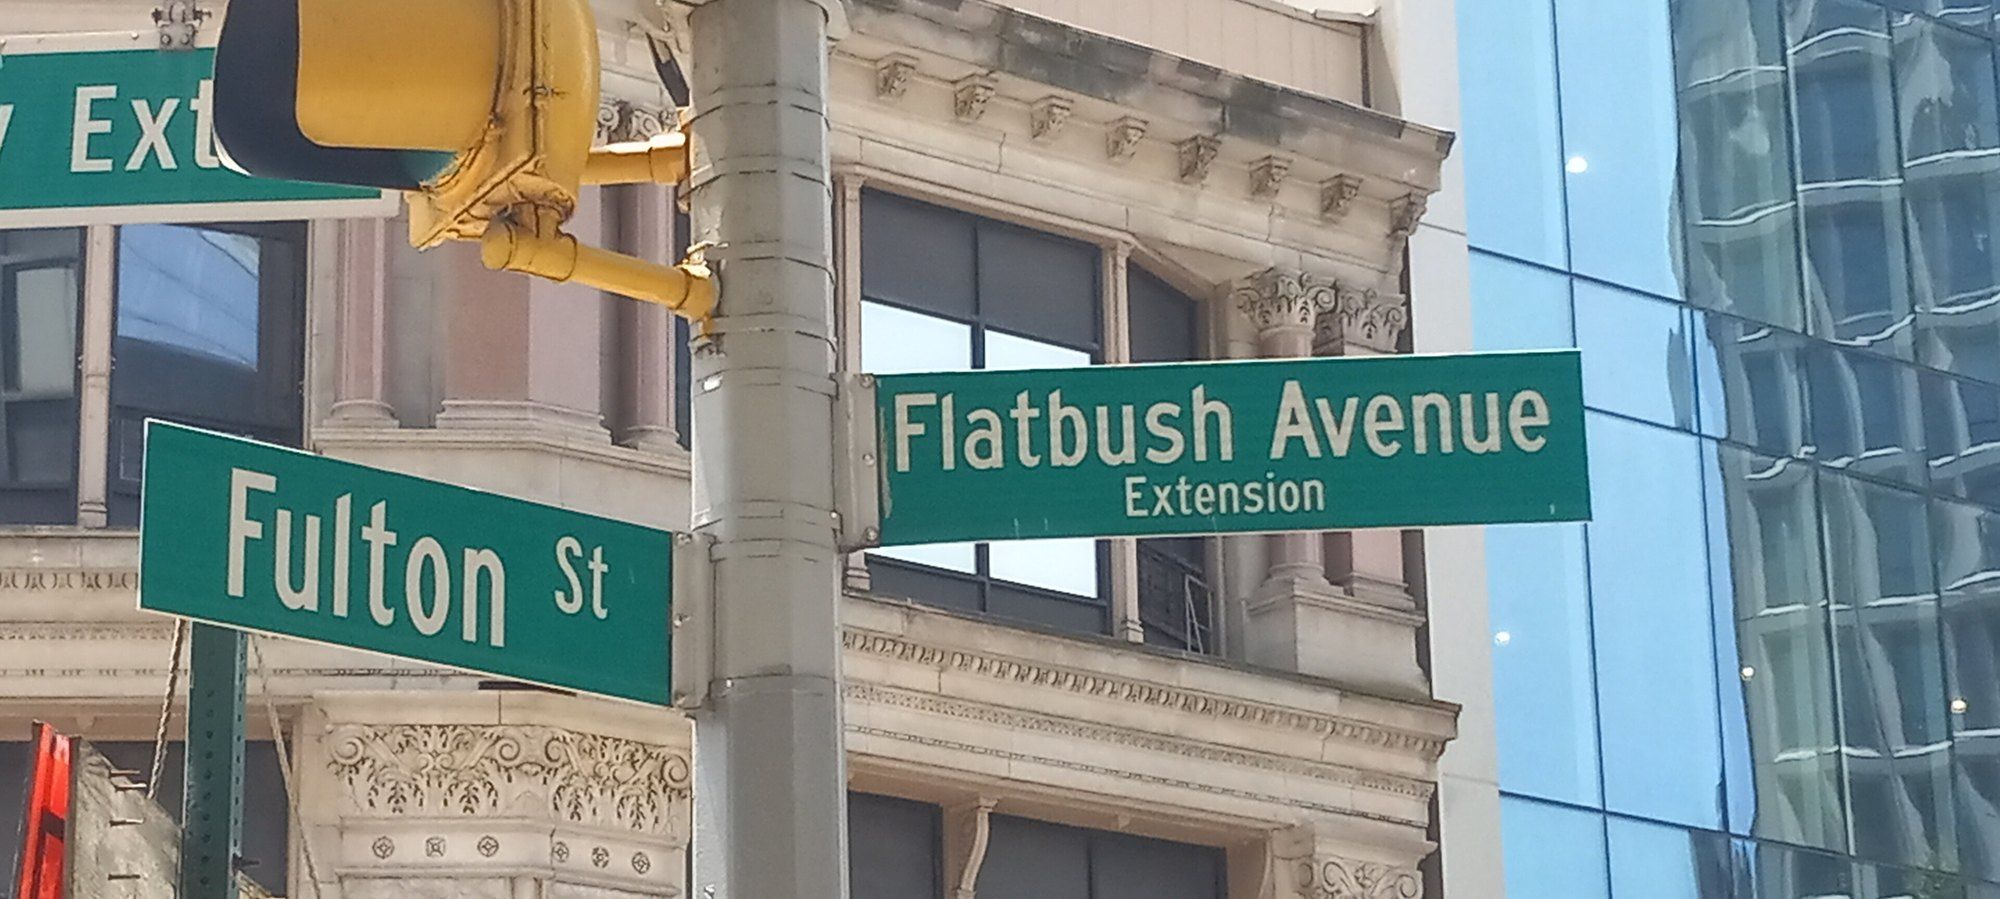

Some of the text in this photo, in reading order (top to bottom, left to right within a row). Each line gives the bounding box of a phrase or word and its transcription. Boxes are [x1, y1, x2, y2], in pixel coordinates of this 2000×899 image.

[71, 80, 220, 172] Ext
[894, 380, 1551, 472] Flatbush Avenue
[1125, 472, 1325, 517] Extension
[227, 467, 609, 648] Fulton St
